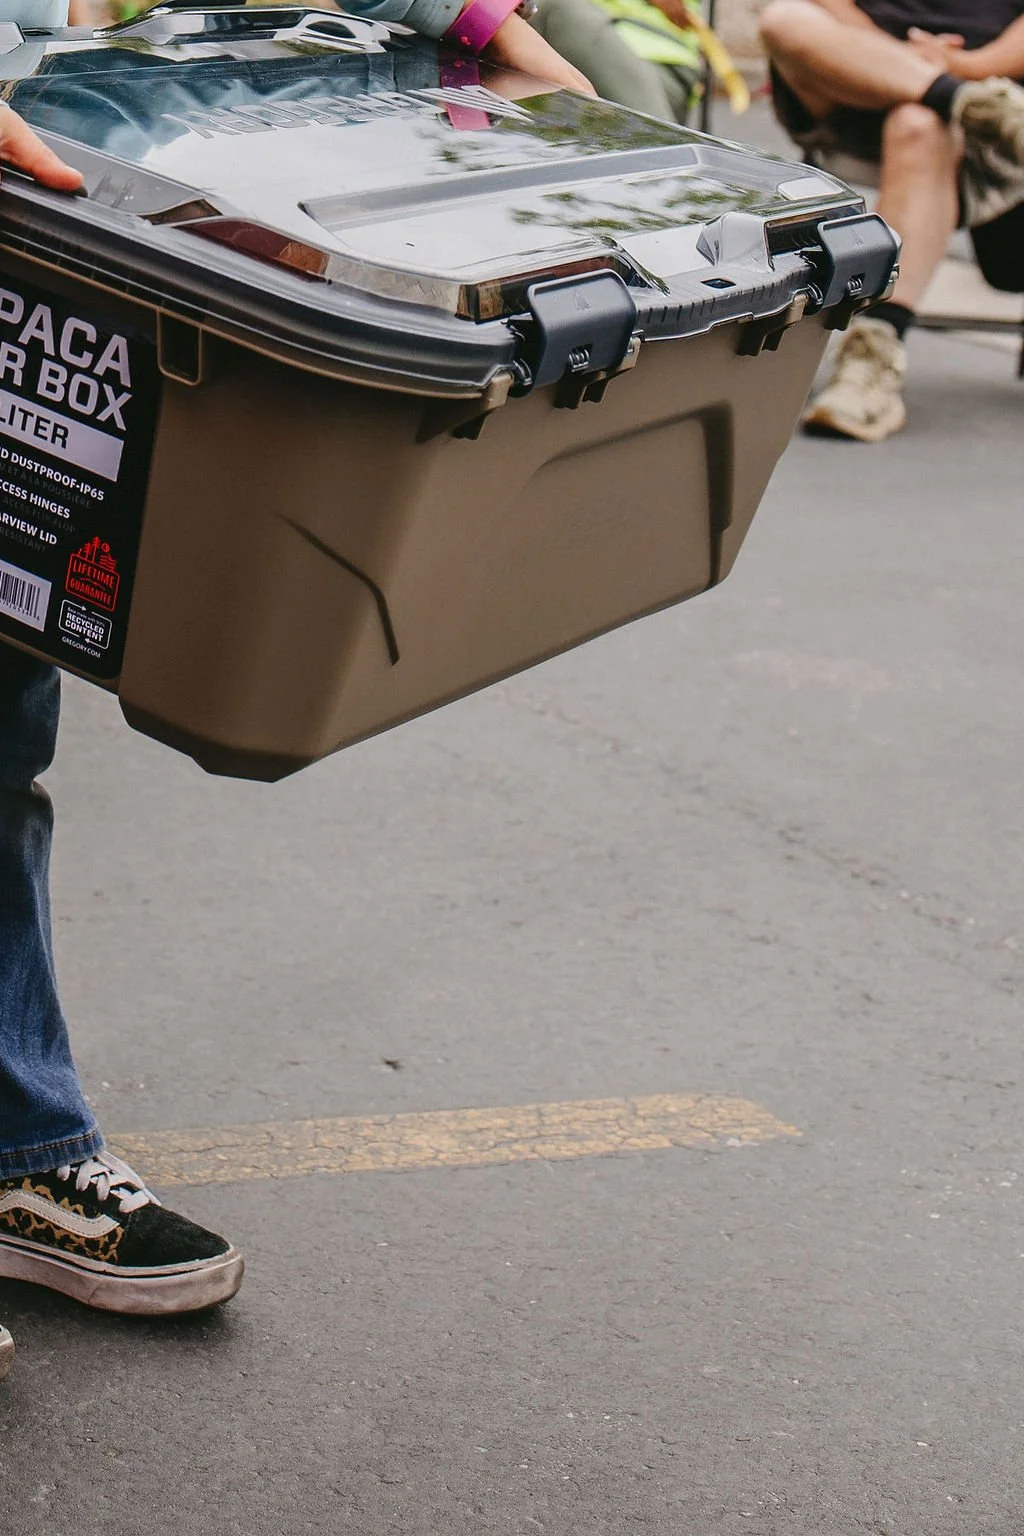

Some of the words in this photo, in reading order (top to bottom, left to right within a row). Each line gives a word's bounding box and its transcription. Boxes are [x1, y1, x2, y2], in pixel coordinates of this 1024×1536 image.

[36, 357, 132, 430] BOX
[10, 452, 104, 500] DUSTPROOF-IP65
[29, 492, 69, 518] HINGES
[39, 529, 56, 544] LID
[72, 559, 114, 588] LIFETIME
[69, 577, 110, 604] GUARANTEE
[65, 619, 103, 641] CONTENT
[66, 612, 104, 634] RECYCLED
